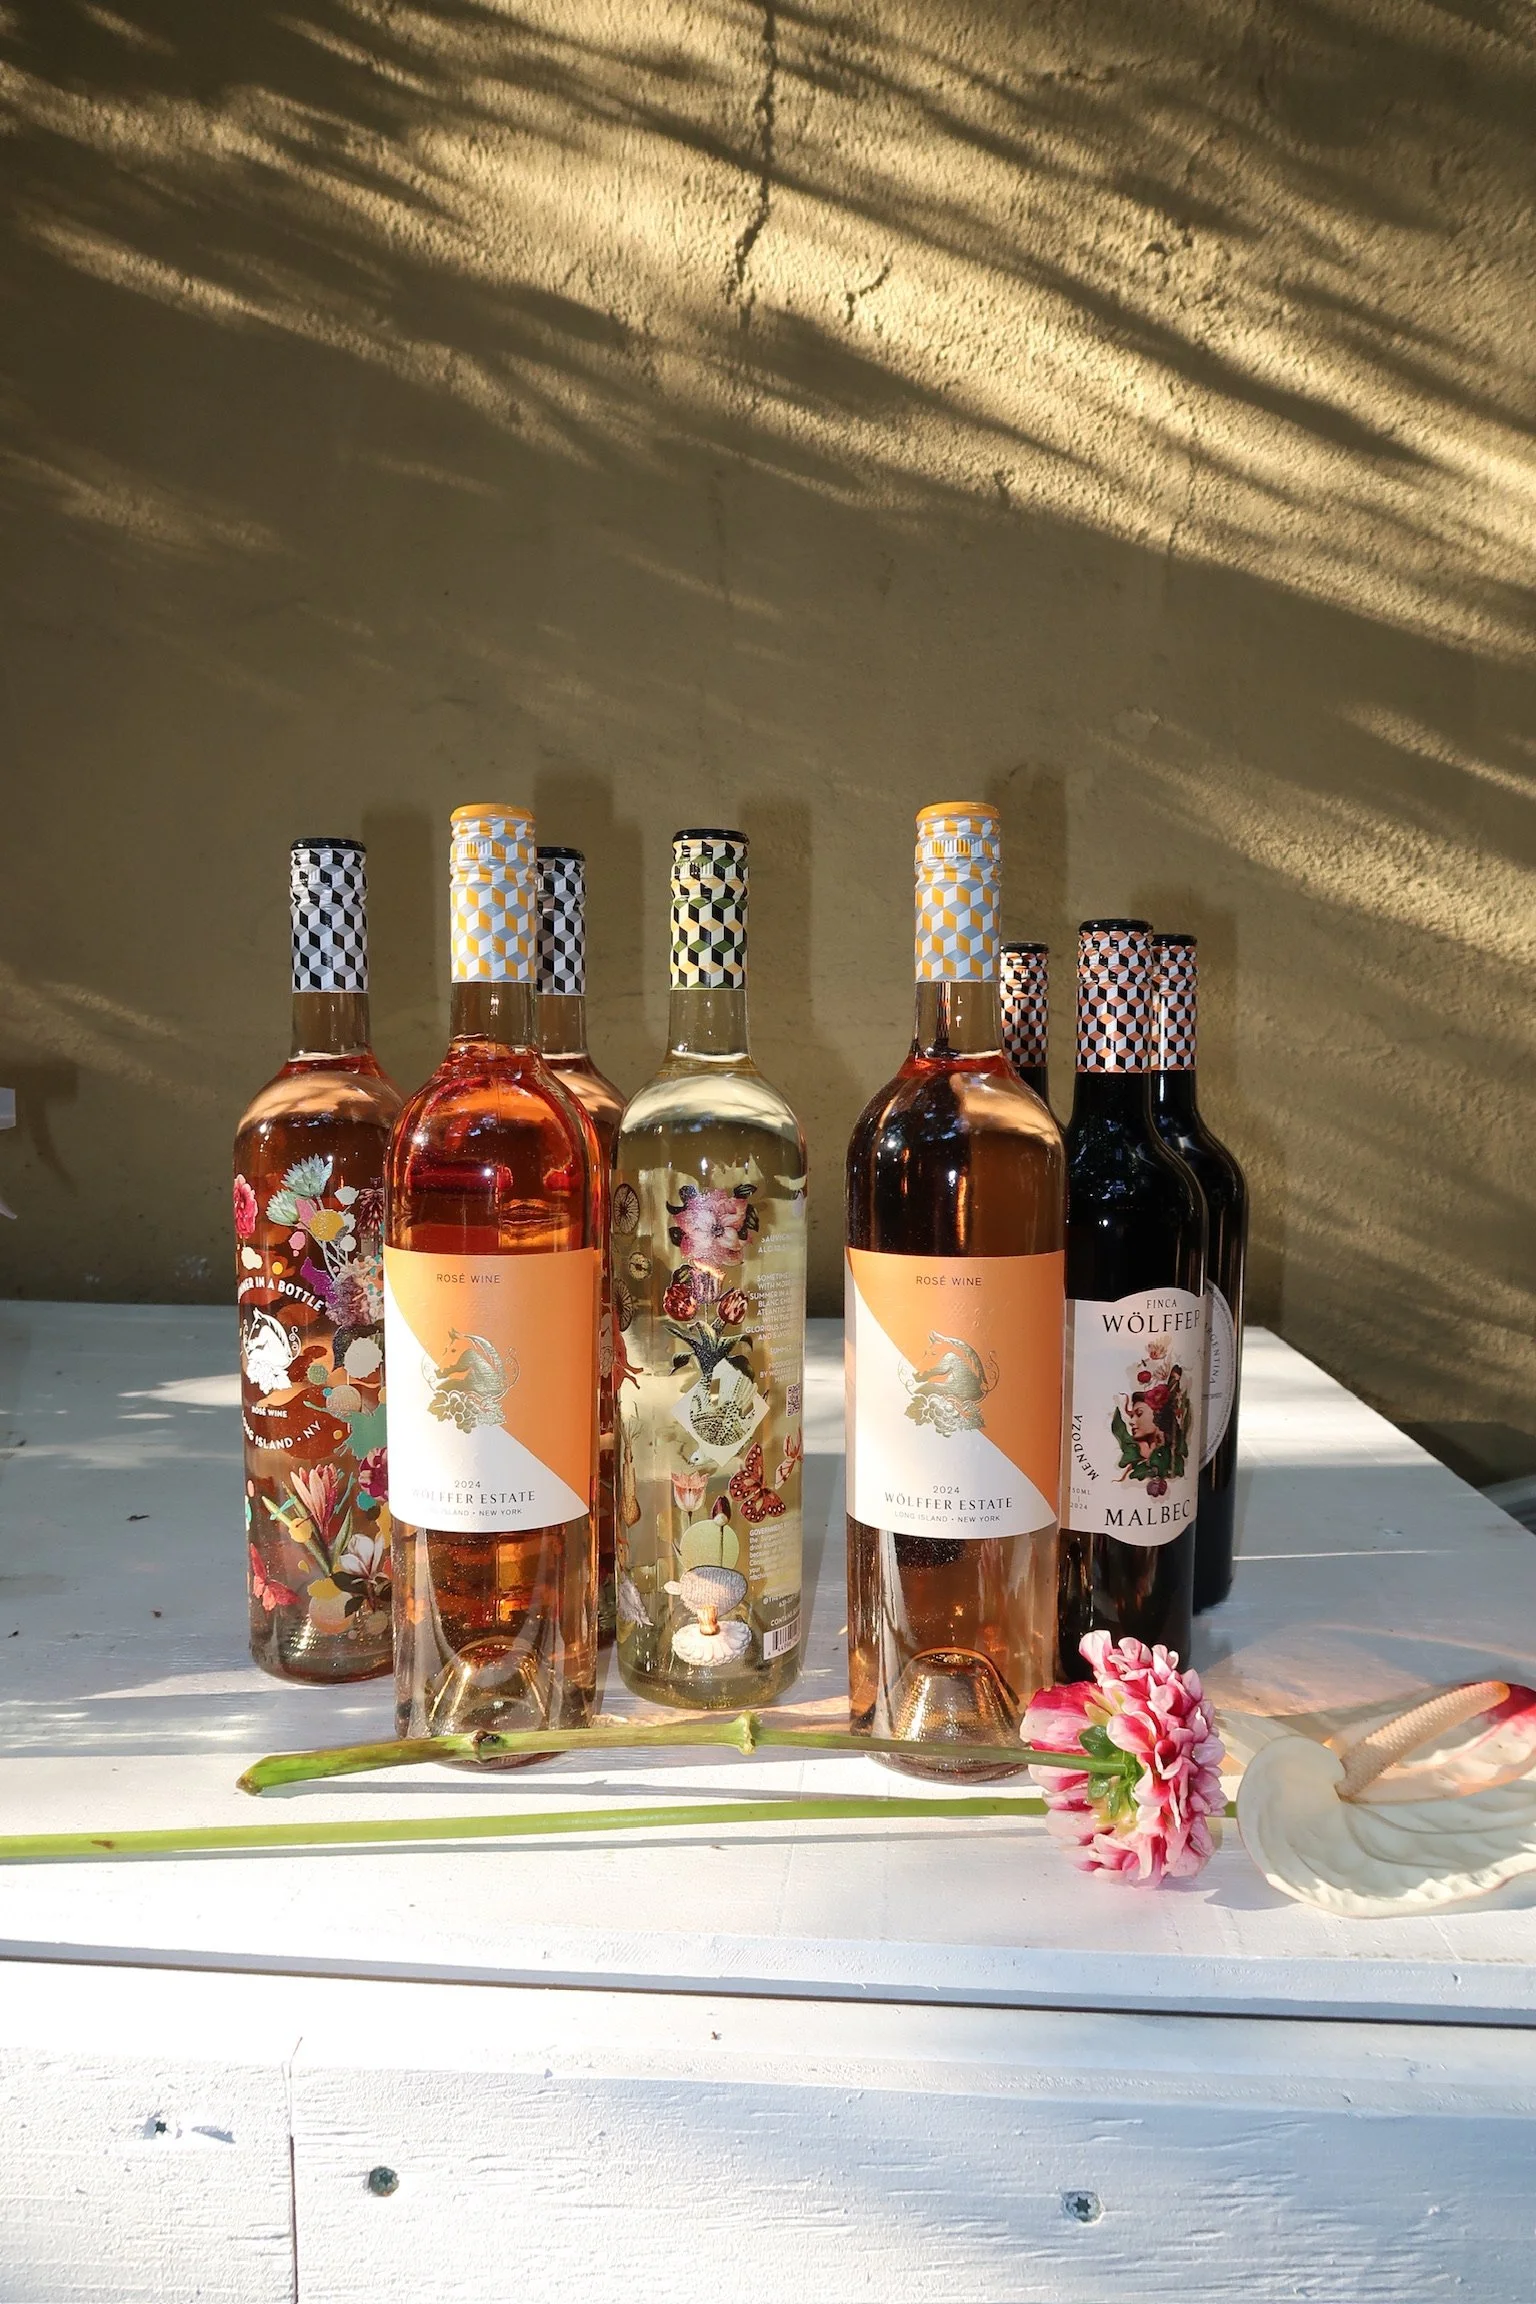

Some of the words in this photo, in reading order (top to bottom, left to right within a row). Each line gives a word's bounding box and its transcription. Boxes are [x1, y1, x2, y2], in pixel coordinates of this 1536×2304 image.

[436, 1273, 465, 1284] ROSÉ
[470, 1274, 501, 1284] WINE
[916, 1276, 946, 1286] ROSÉ
[951, 1277, 982, 1286] WINE
[255, 1276, 265, 1288] IN
[268, 1278, 275, 1291] A
[278, 1280, 325, 1312] BOTTLE
[758, 1298, 779, 1308] BLANC
[1146, 1299, 1177, 1309] FINCA
[745, 1324, 778, 1334] GLORIOUS
[758, 1332, 772, 1341] AND
[760, 1370, 768, 1379] BY
[268, 1409, 288, 1418] WINE
[255, 1435, 293, 1449] ISLAND
[303, 1420, 321, 1439] NY
[1072, 1415, 1100, 1480] MENDOZA
[454, 1480, 481, 1489] 2024
[933, 1485, 960, 1494] 2024
[1068, 1487, 1091, 1495] 750ML
[480, 1490, 535, 1504] ESTATE
[885, 1491, 952, 1510] WÖLFFER
[959, 1497, 1013, 1511] ESTATE
[1070, 1502, 1088, 1510] 2024
[479, 1509, 497, 1517] NEW
[501, 1508, 522, 1516] YORK
[895, 1510, 915, 1519] LONG
[918, 1513, 948, 1523] ISLAND
[979, 1514, 1000, 1522] YORK
[1105, 1499, 1190, 1526] MALBEC
